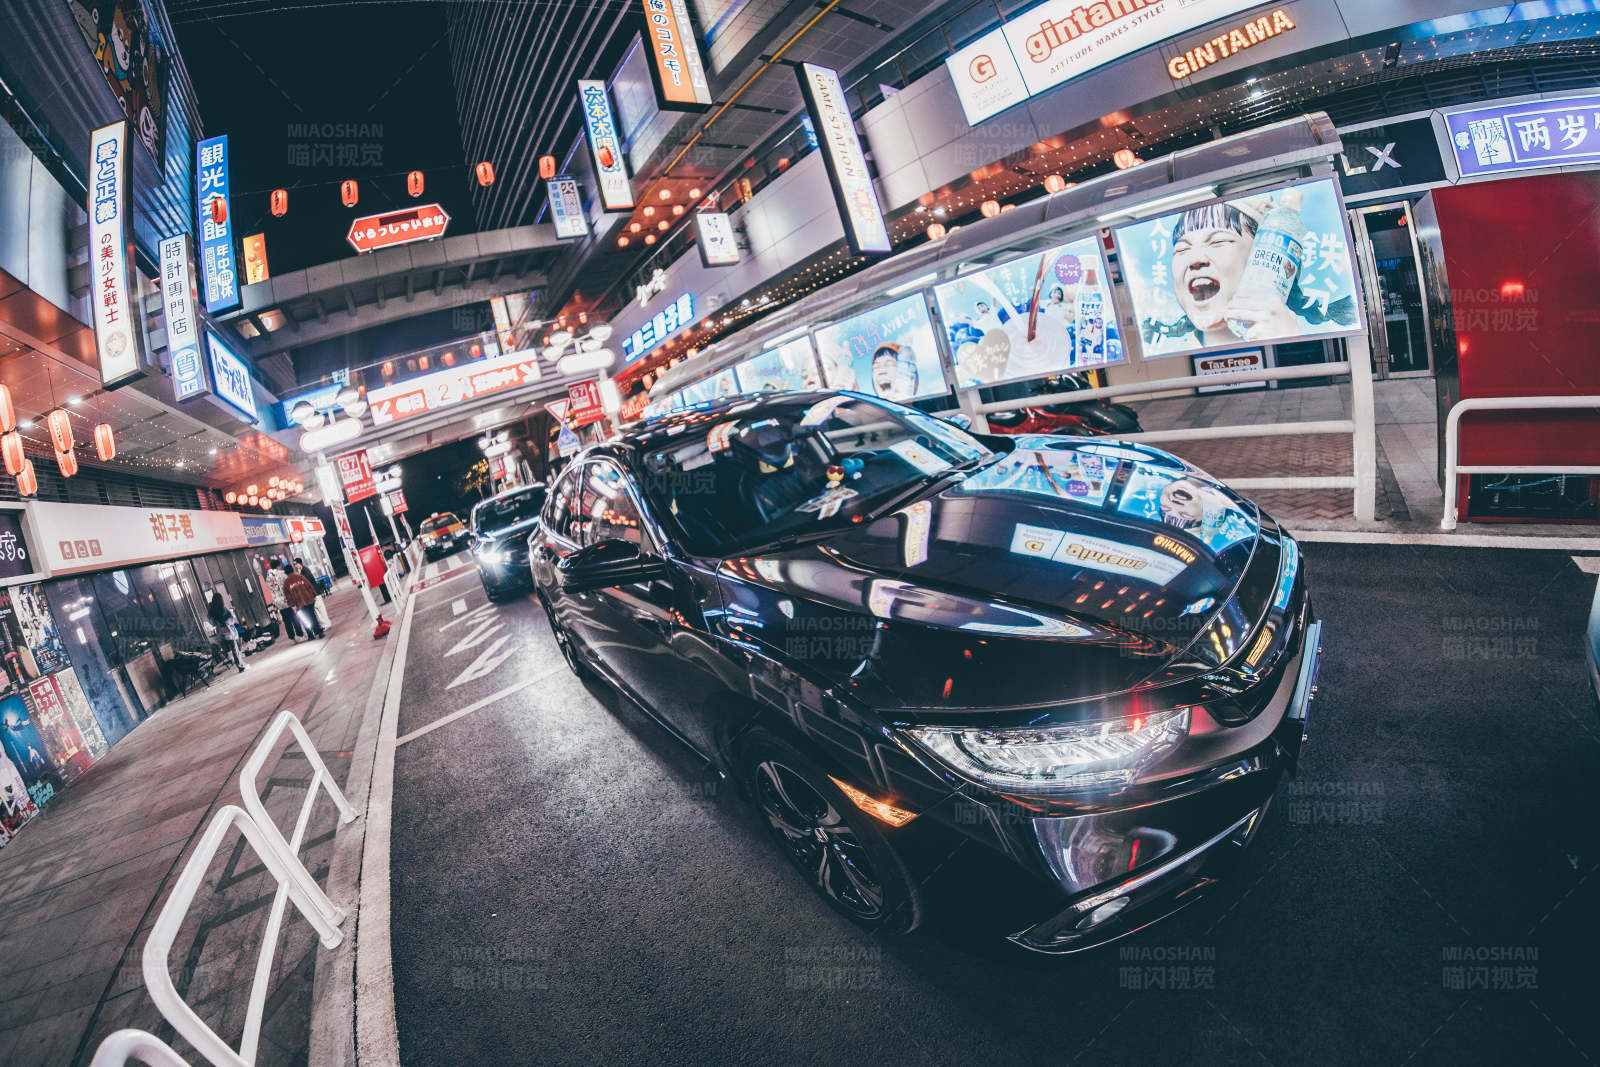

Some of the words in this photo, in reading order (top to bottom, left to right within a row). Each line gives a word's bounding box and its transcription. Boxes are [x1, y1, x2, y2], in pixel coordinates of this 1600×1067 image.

[1096, 23, 1129, 47] MAKES
[1167, 9, 1297, 80] GINTAMA
[1514, 112, 1600, 152] 两岁
[1254, 249, 1283, 265] GREEN
[1208, 360, 1225, 369] Tax
[1227, 358, 1251, 368] Free
